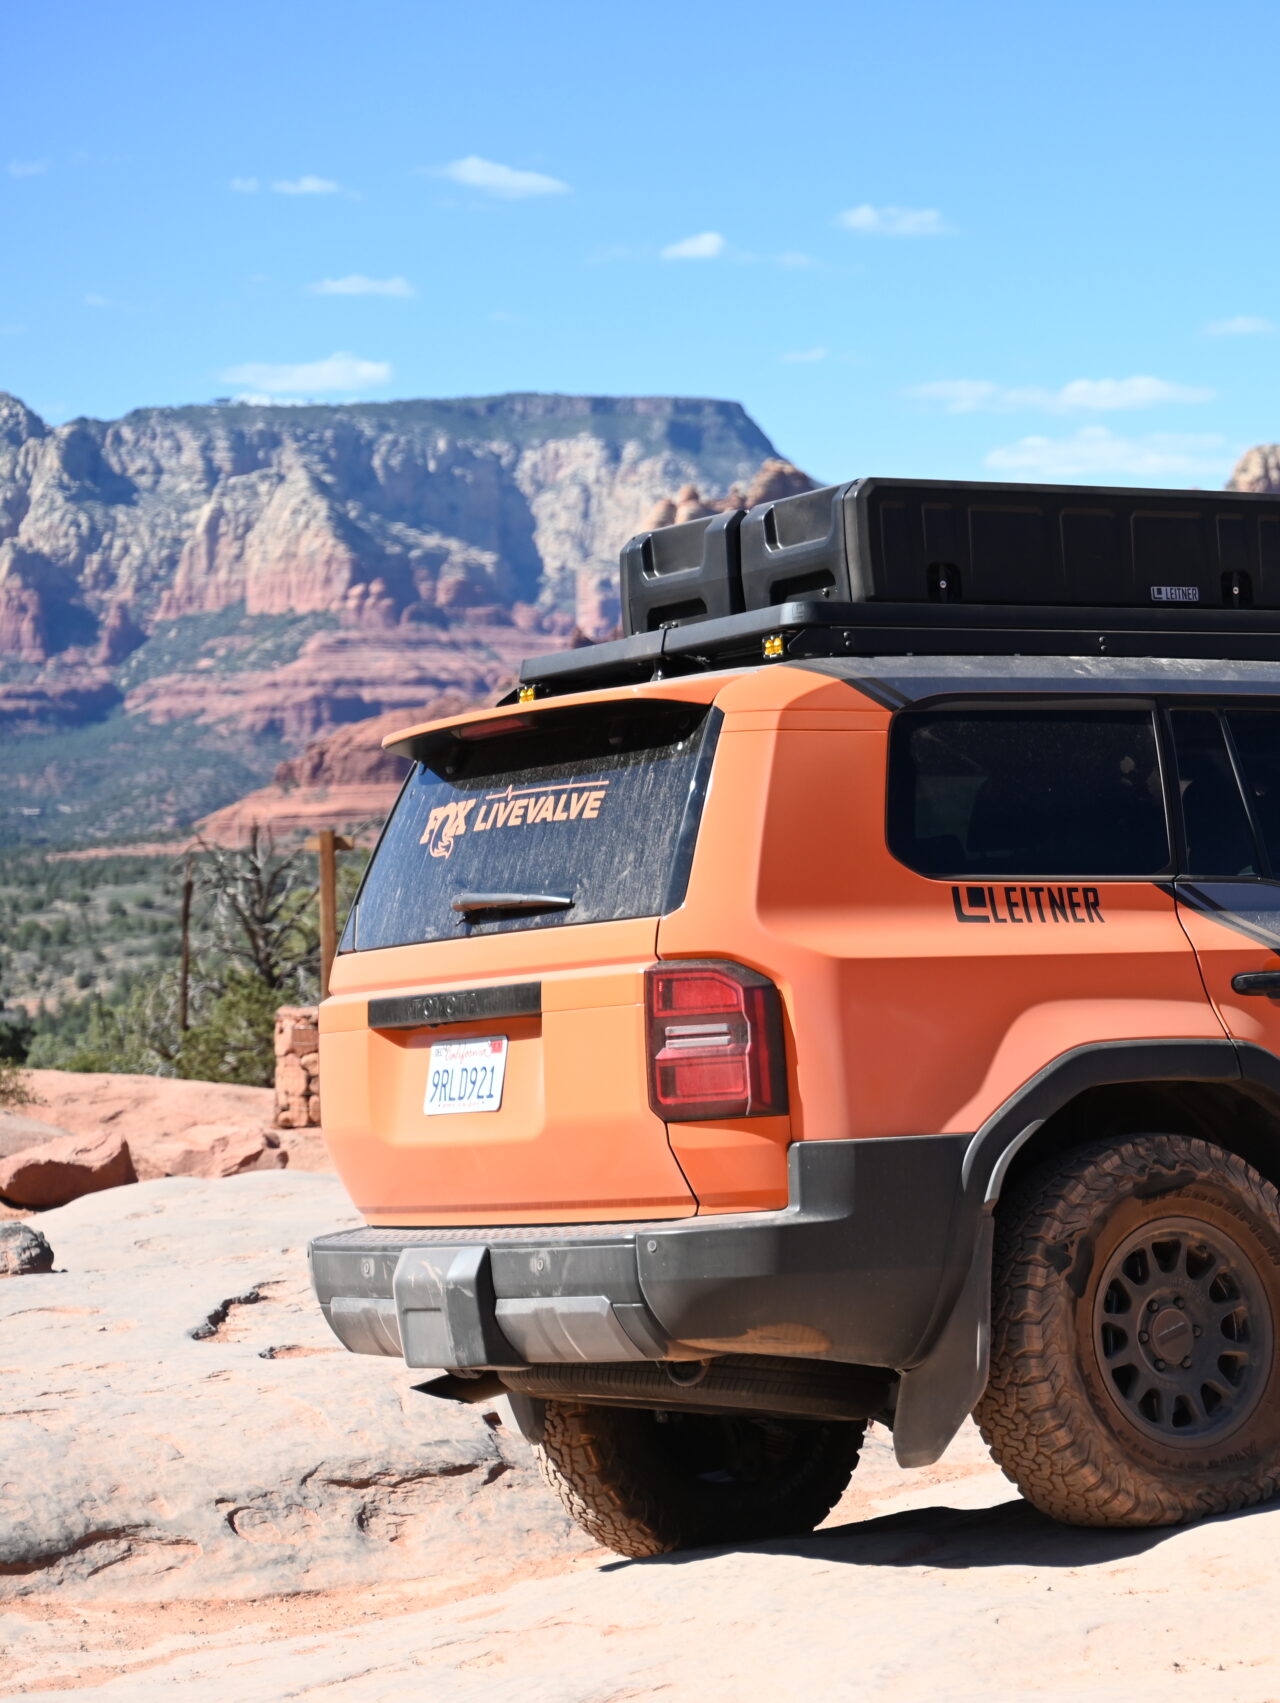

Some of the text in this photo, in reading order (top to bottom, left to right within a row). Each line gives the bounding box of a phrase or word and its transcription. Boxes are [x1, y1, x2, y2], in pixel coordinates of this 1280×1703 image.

[1166, 588, 1197, 600] LEITNER
[420, 791, 606, 859] FOX LIVEVALVE
[987, 886, 1105, 923] LEITNER
[430, 1066, 495, 1103] 9RLD921
